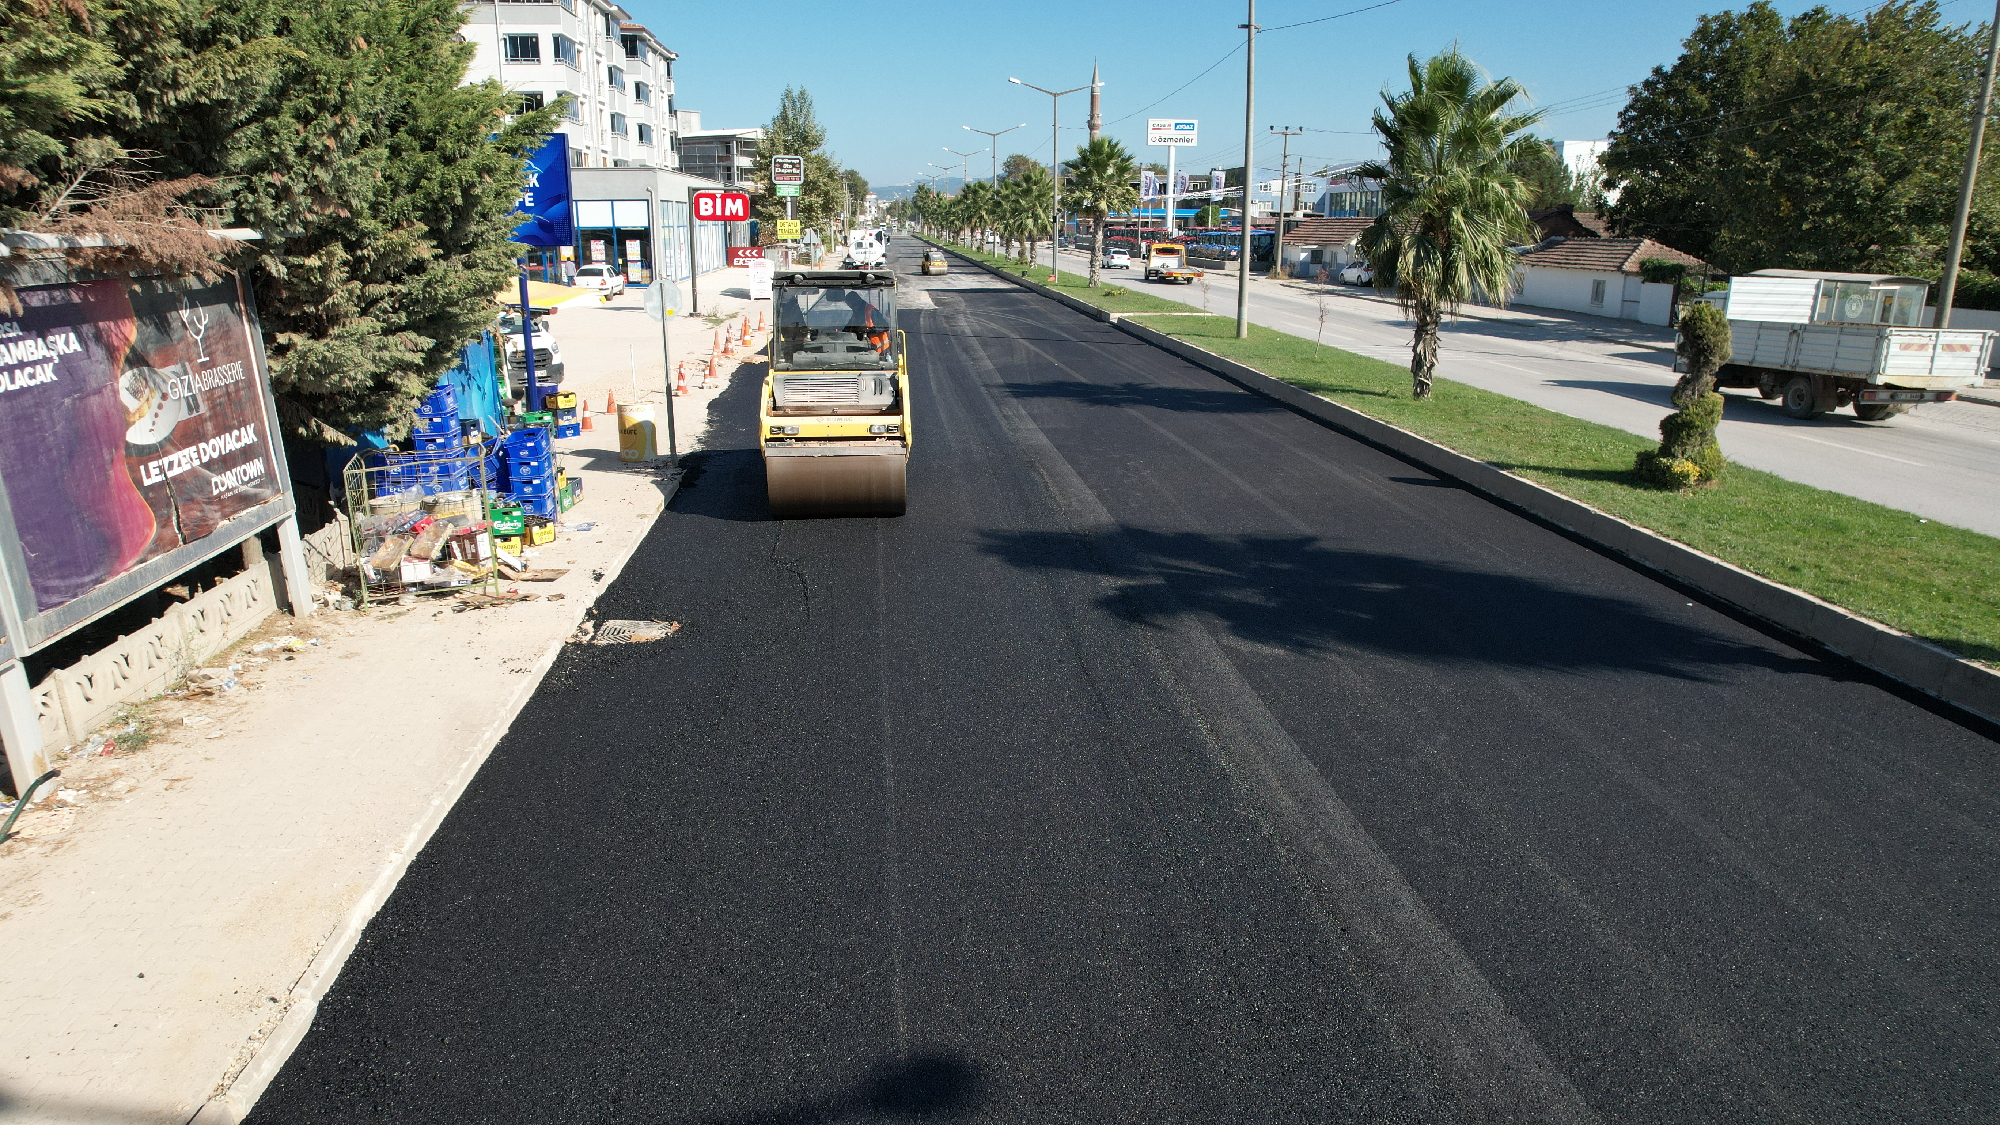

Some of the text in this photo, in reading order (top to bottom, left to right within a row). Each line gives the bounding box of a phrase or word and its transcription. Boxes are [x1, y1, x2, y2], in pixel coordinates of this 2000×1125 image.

[1157, 135, 1194, 144] özmenler
[698, 193, 744, 217] BİM
[199, 423, 258, 464] DOYACAK
[211, 456, 265, 496] DOWNTOWN
[493, 519, 522, 530] Carlsberg
